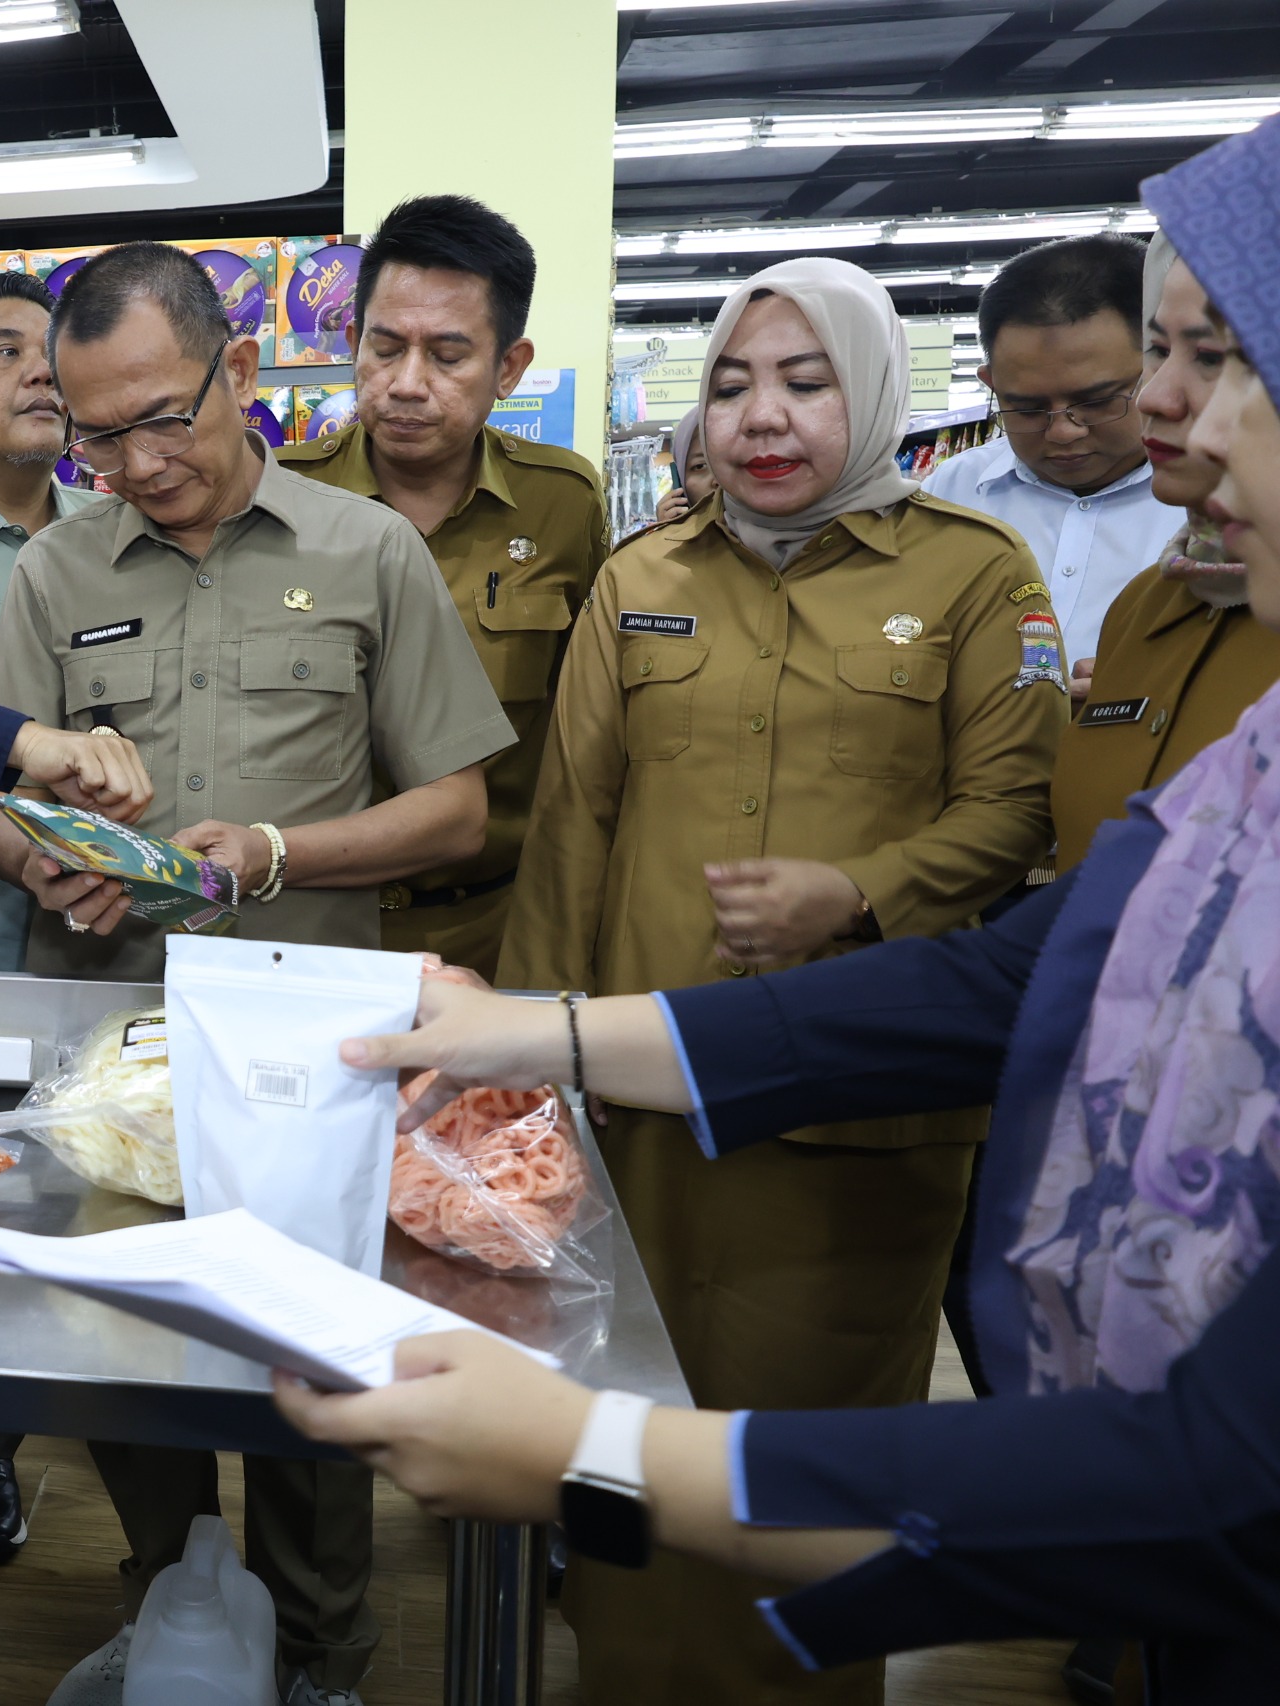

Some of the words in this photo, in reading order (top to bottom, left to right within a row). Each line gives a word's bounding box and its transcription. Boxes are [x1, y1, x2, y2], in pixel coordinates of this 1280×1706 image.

[298, 257, 346, 307] Deka
[661, 365, 694, 376] Snack
[496, 400, 540, 409] ISTIMEWA
[626, 617, 652, 628] JAMIAH
[653, 619, 687, 630] HARYANTI
[80, 624, 131, 642] GUNAWAN
[1092, 704, 1132, 717] KORLENA
